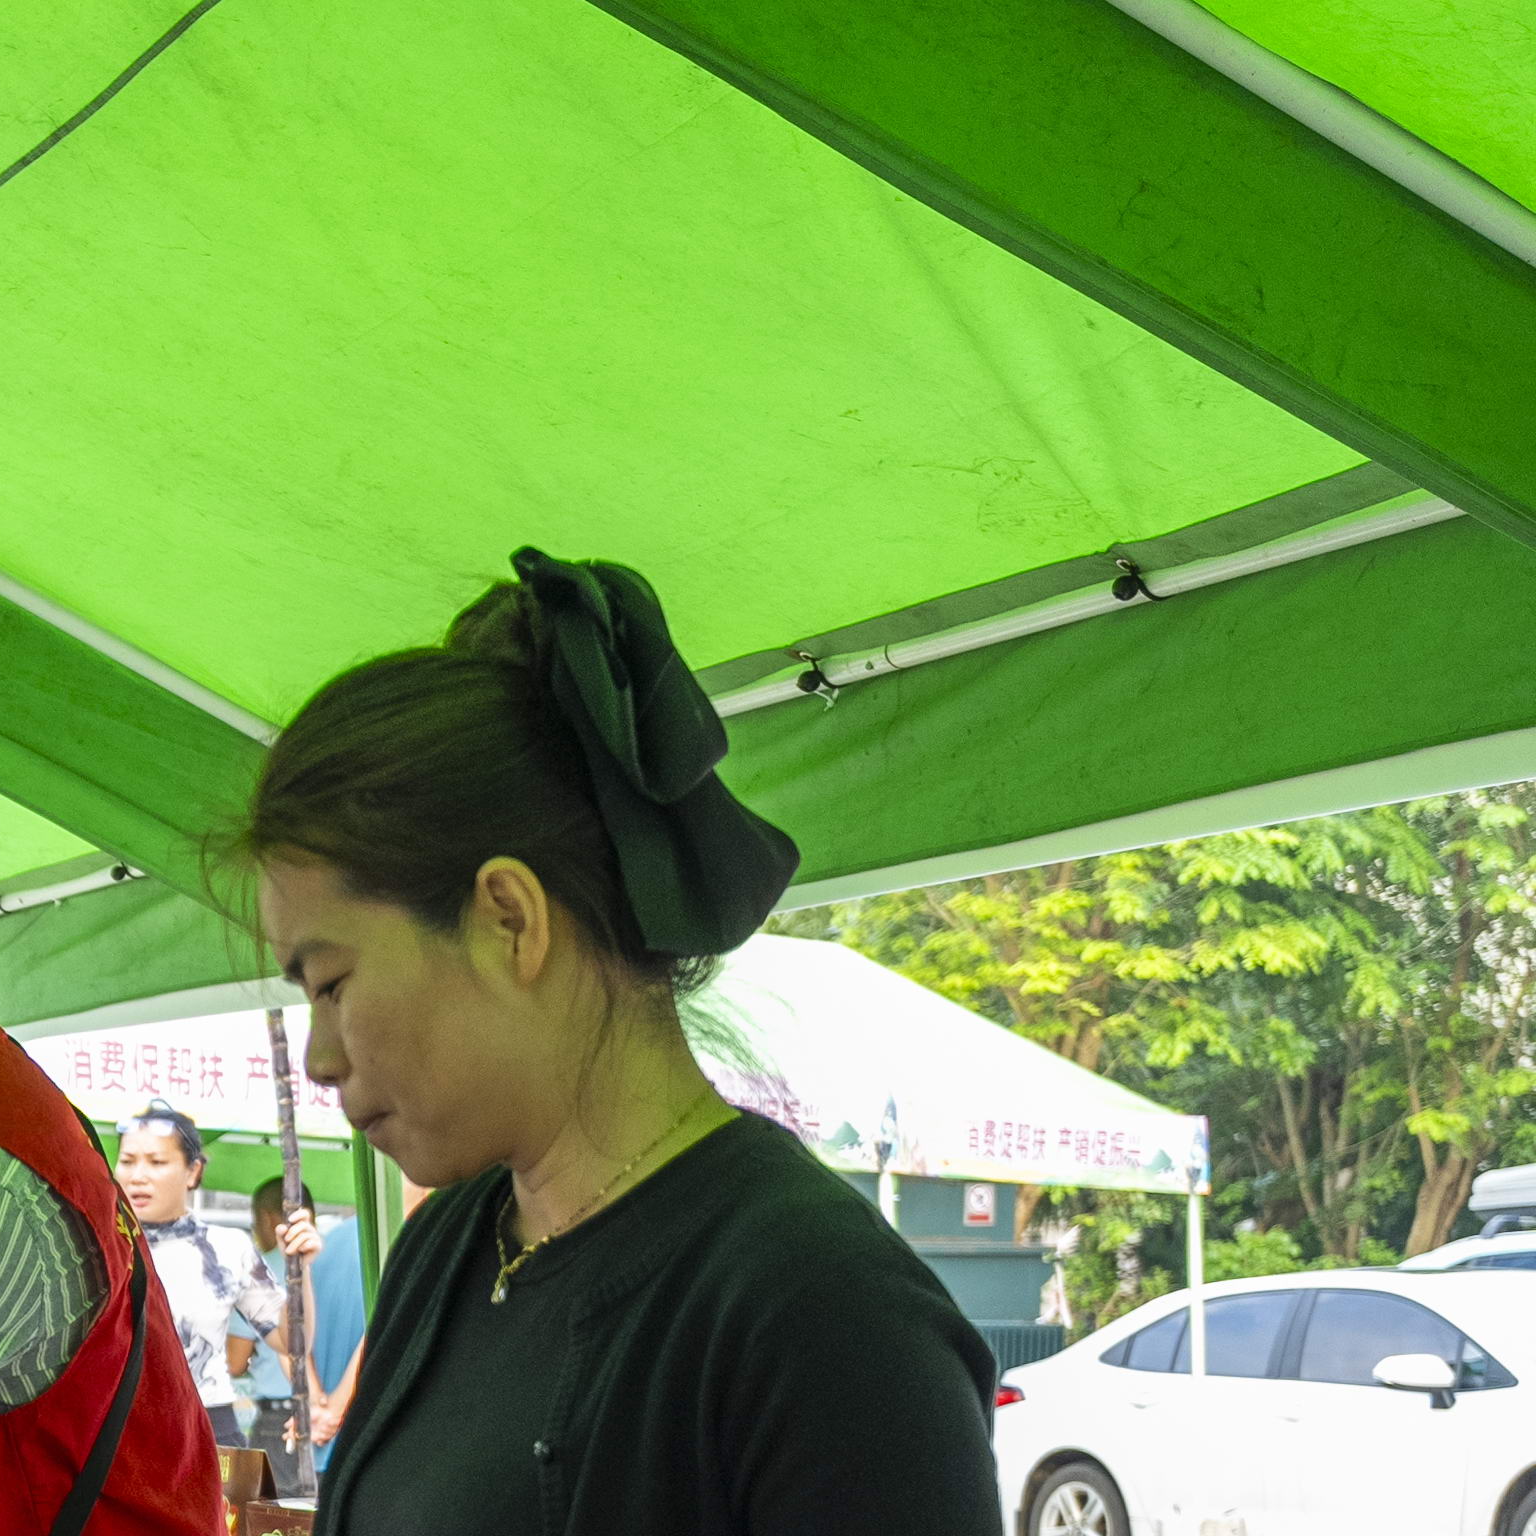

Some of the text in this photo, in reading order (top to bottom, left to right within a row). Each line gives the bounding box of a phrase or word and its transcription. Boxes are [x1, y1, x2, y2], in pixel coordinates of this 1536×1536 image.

[64, 1039, 225, 1099] 消费促帮扶
